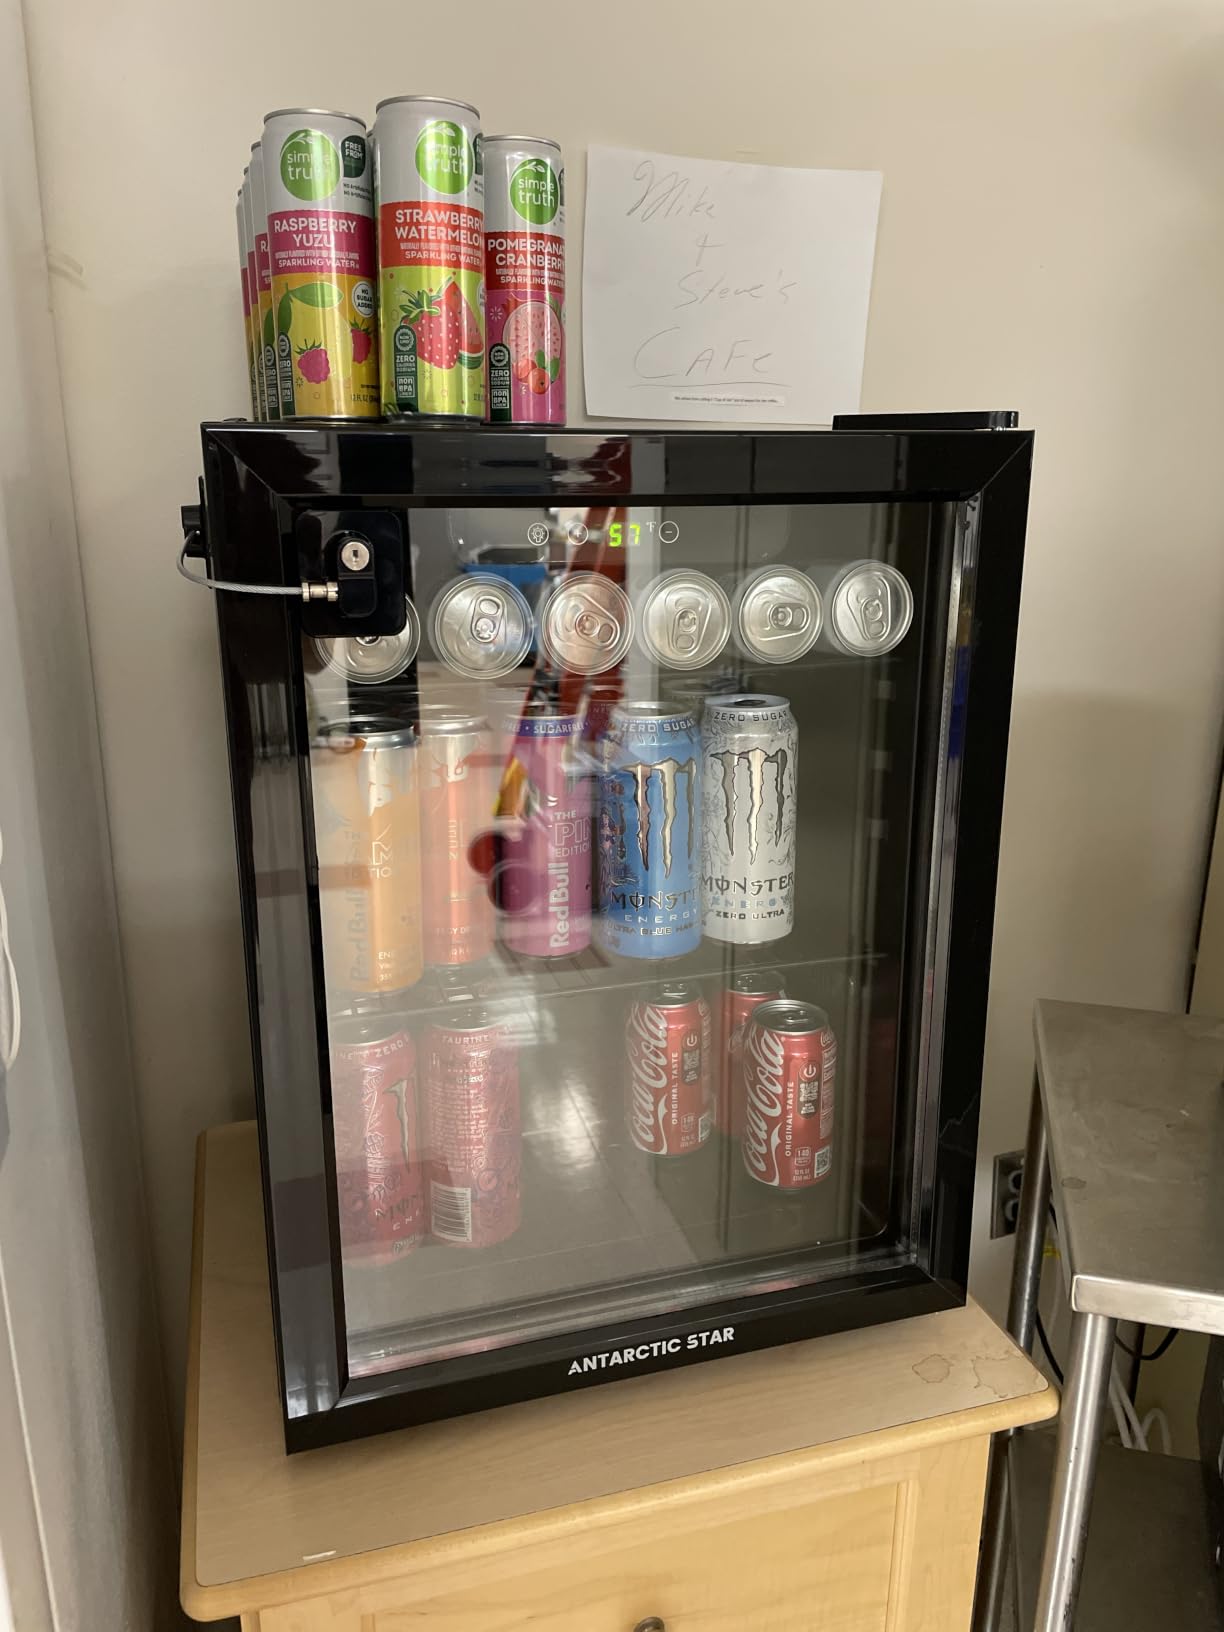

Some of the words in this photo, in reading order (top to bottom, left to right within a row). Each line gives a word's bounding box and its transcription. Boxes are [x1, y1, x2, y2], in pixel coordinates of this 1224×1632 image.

[518, 175, 555, 192] simple
[626, 160, 715, 222] Mike
[518, 189, 555, 208] truth
[274, 217, 356, 233] RASPBERRY
[293, 233, 334, 247] YUZU
[278, 258, 324, 268] SPARKLING
[405, 250, 457, 261] SPARKLING
[396, 354, 416, 363] ZERO
[491, 369, 510, 377] ZERO
[609, 523, 641, 547] 57
[713, 711, 746, 722] ZERO
[752, 710, 788, 722] SUGAR
[621, 723, 657, 732] ZERO
[554, 811, 577, 820] THE
[547, 862, 569, 903] Bull
[701, 872, 794, 897] MONSTER
[715, 910, 747, 920] ZERO
[752, 908, 786, 920] ULTRA
[549, 905, 570, 948] Red
[640, 926, 672, 936] BLUE
[671, 1052, 679, 1080] TASTE
[786, 1081, 794, 1109] TASTE
[785, 1112, 793, 1157] ORIGINAL
[567, 1338, 681, 1376] ANTARCTIC
[686, 1327, 735, 1349] STAR
